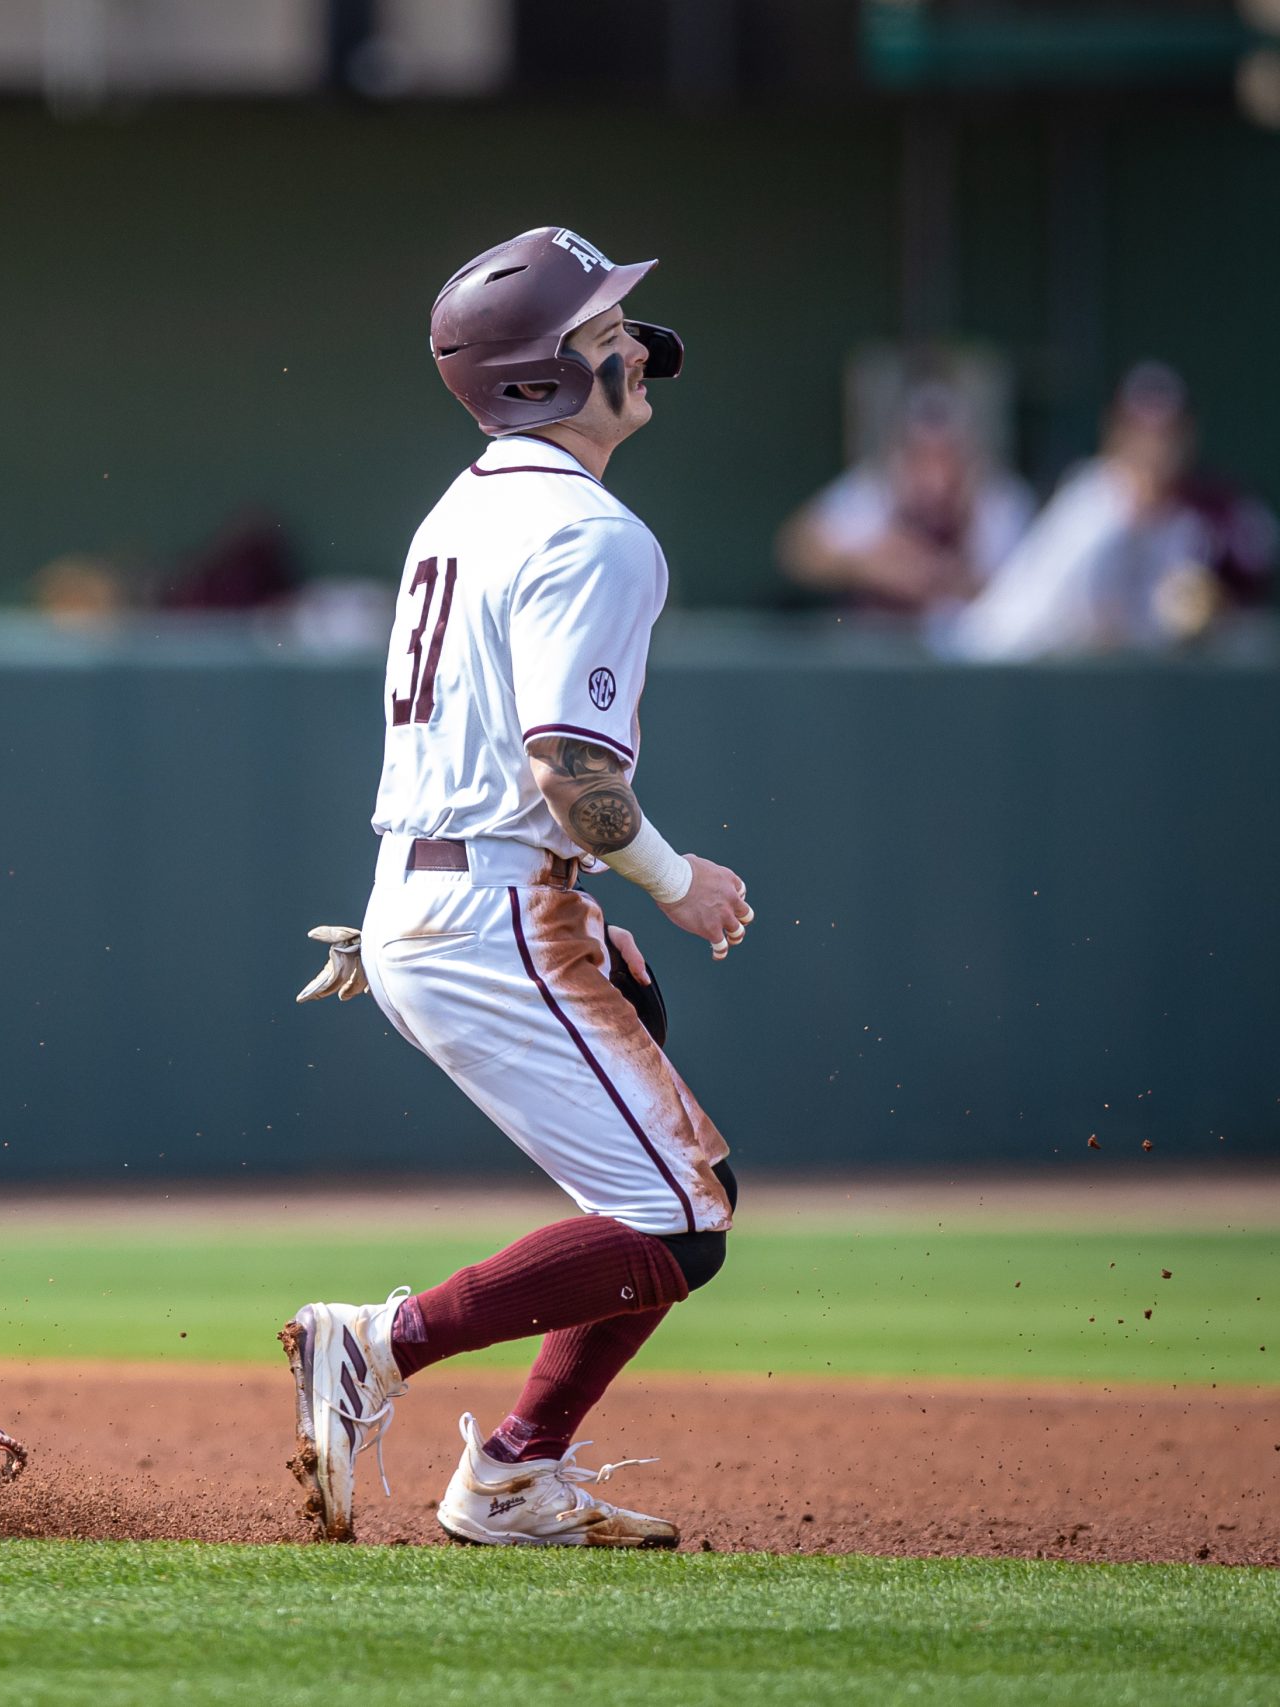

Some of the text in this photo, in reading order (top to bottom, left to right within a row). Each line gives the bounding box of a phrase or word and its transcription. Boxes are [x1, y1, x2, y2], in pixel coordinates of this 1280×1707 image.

[392, 556, 458, 727] 31
[589, 669, 615, 709] SEC
[489, 1496, 526, 1516] Aggies
